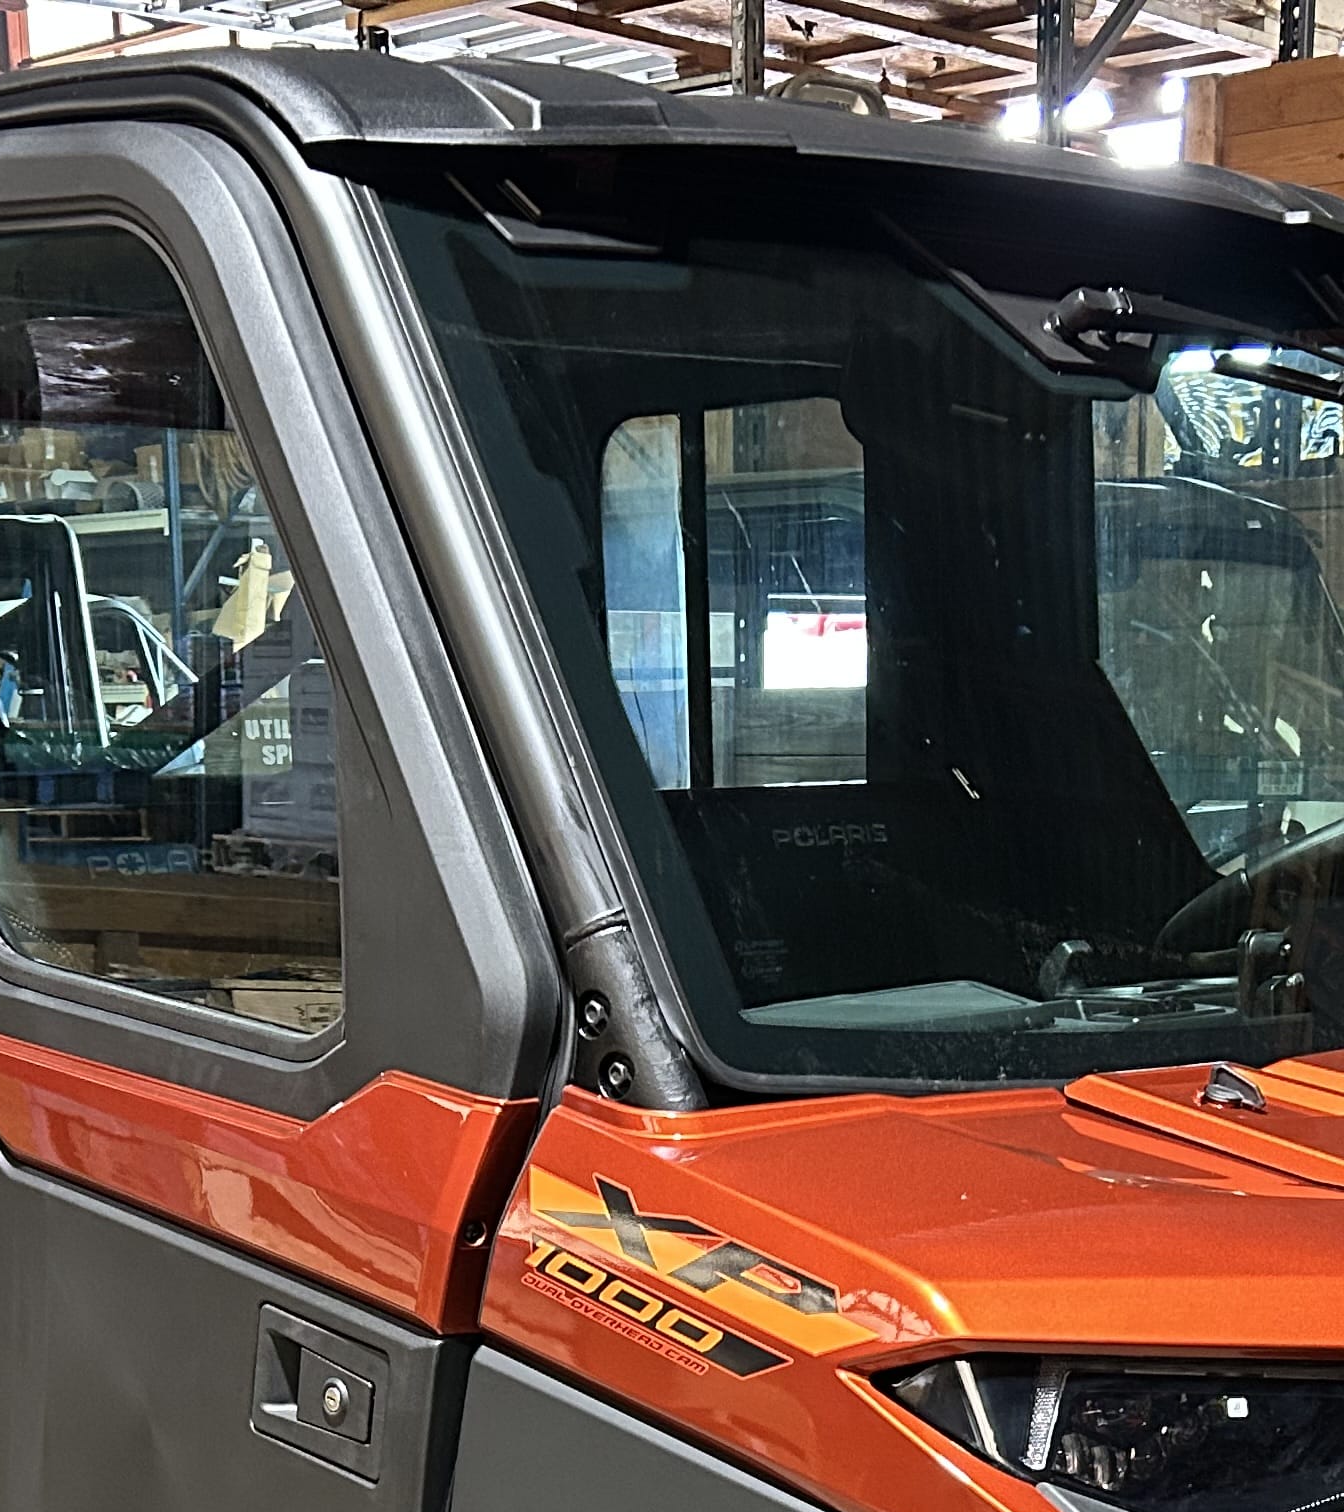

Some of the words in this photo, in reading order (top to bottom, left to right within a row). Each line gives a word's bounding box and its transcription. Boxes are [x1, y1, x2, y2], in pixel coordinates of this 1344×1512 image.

[261, 743, 293, 766] SP
[771, 823, 889, 849] POLARIS
[535, 1173, 840, 1315] XP
[523, 1274, 570, 1300] DUAL
[570, 1298, 664, 1351] OVERHEAD
[664, 1347, 707, 1373] CAM
[524, 1238, 725, 1354] 1000
